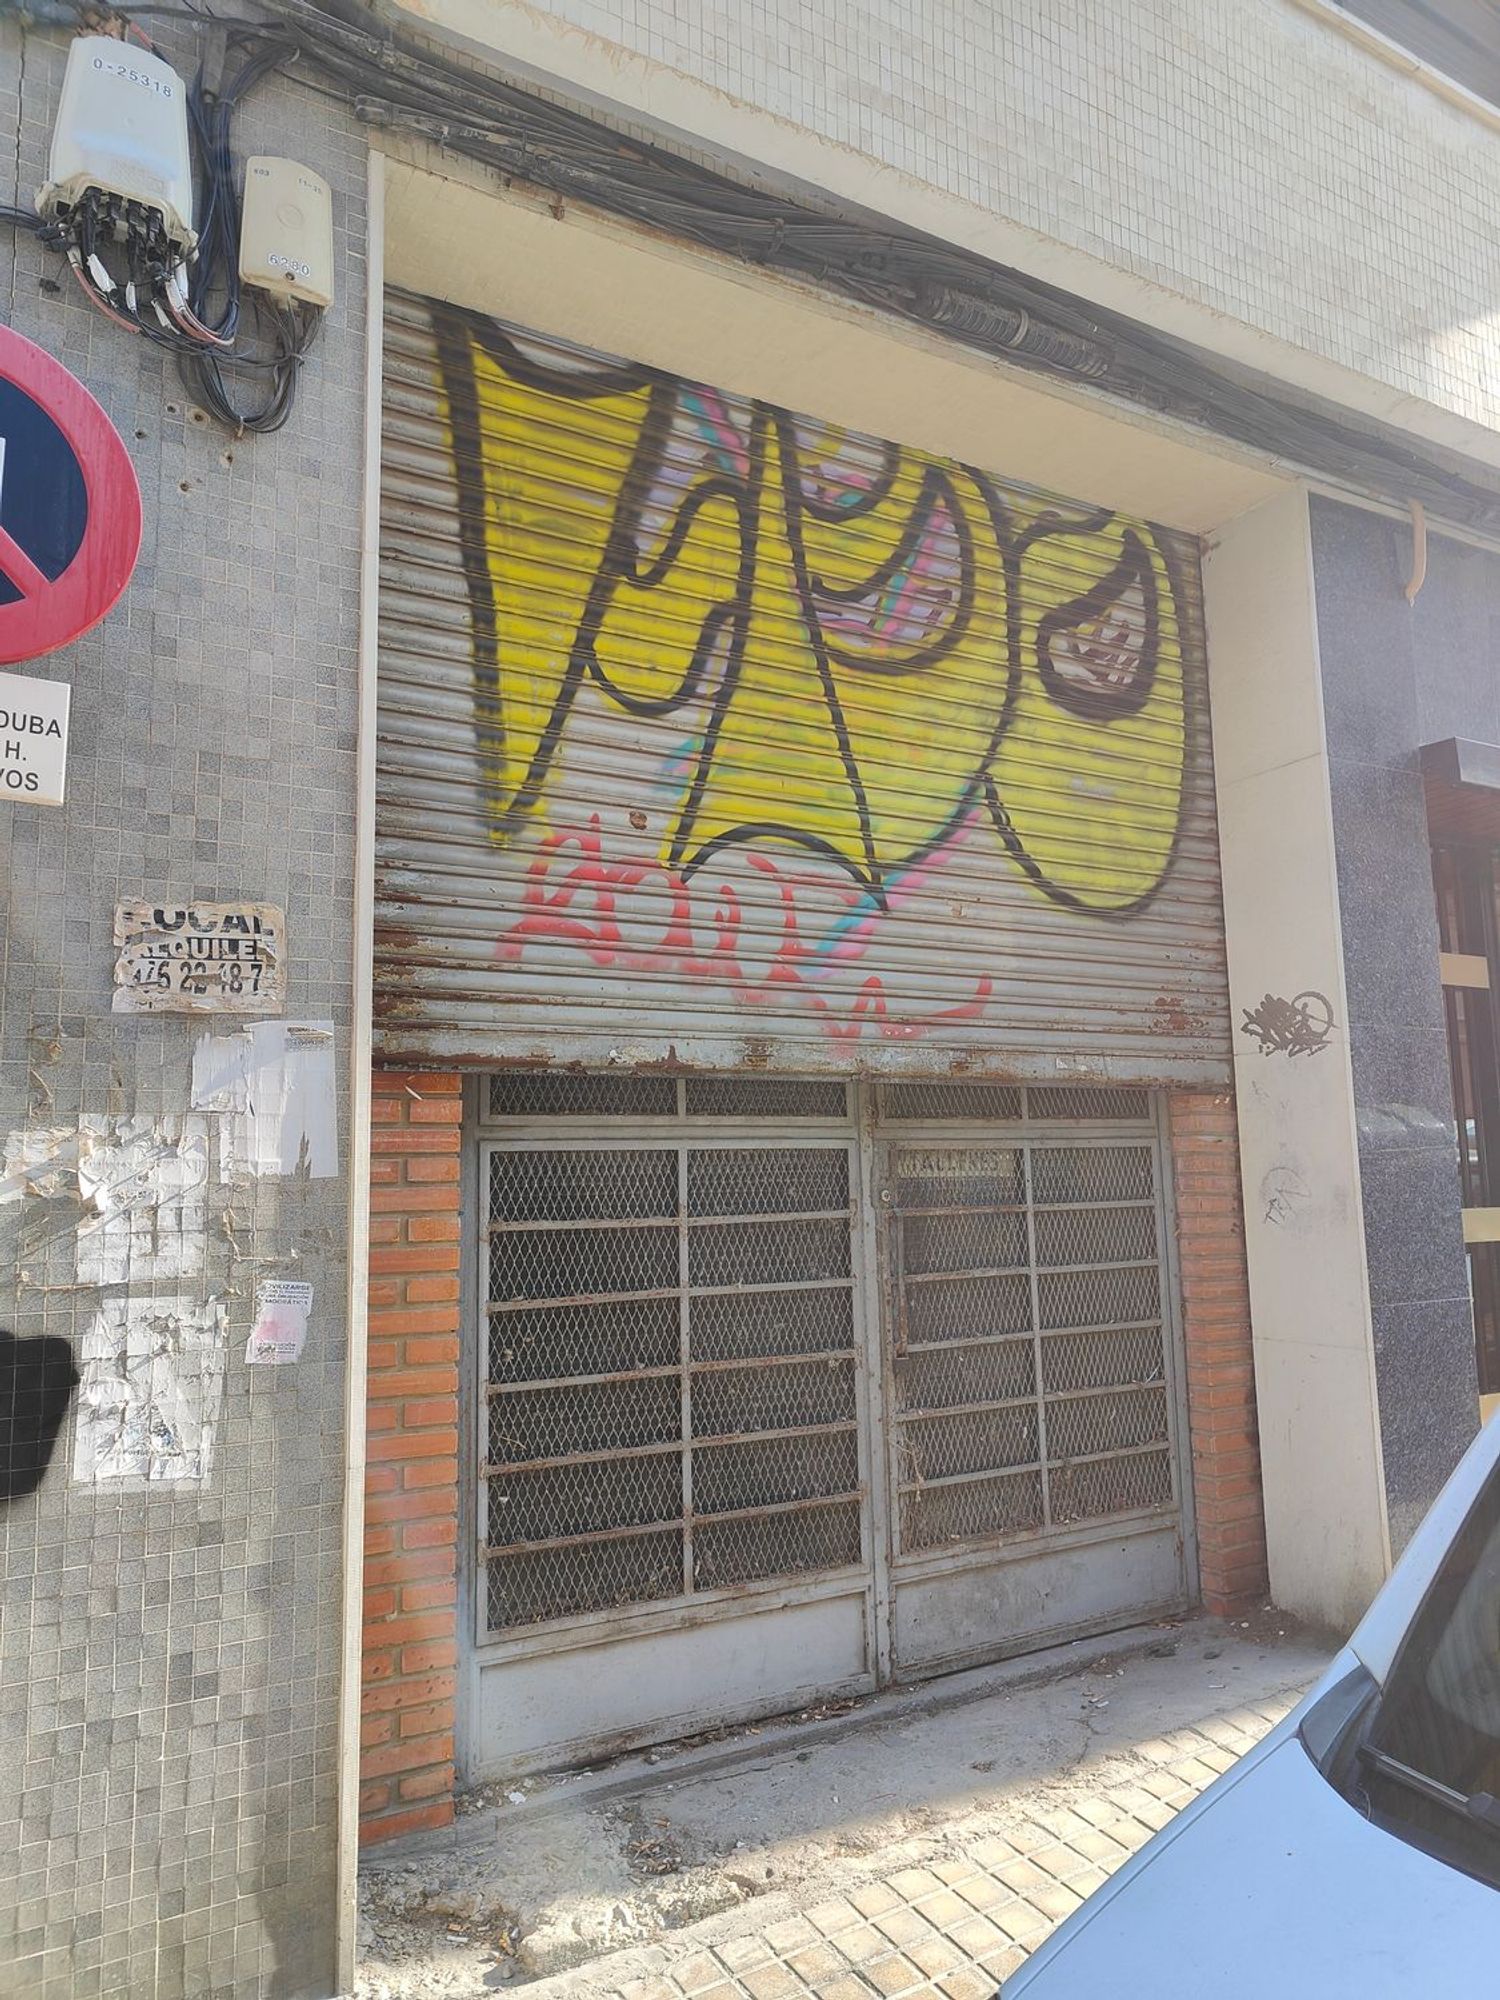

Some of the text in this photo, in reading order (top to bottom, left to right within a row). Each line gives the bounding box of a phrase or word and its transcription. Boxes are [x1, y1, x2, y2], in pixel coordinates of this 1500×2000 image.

[269, 253, 310, 277] 6280
[5, 739, 27, 761] H.
[0, 767, 39, 792] OS
